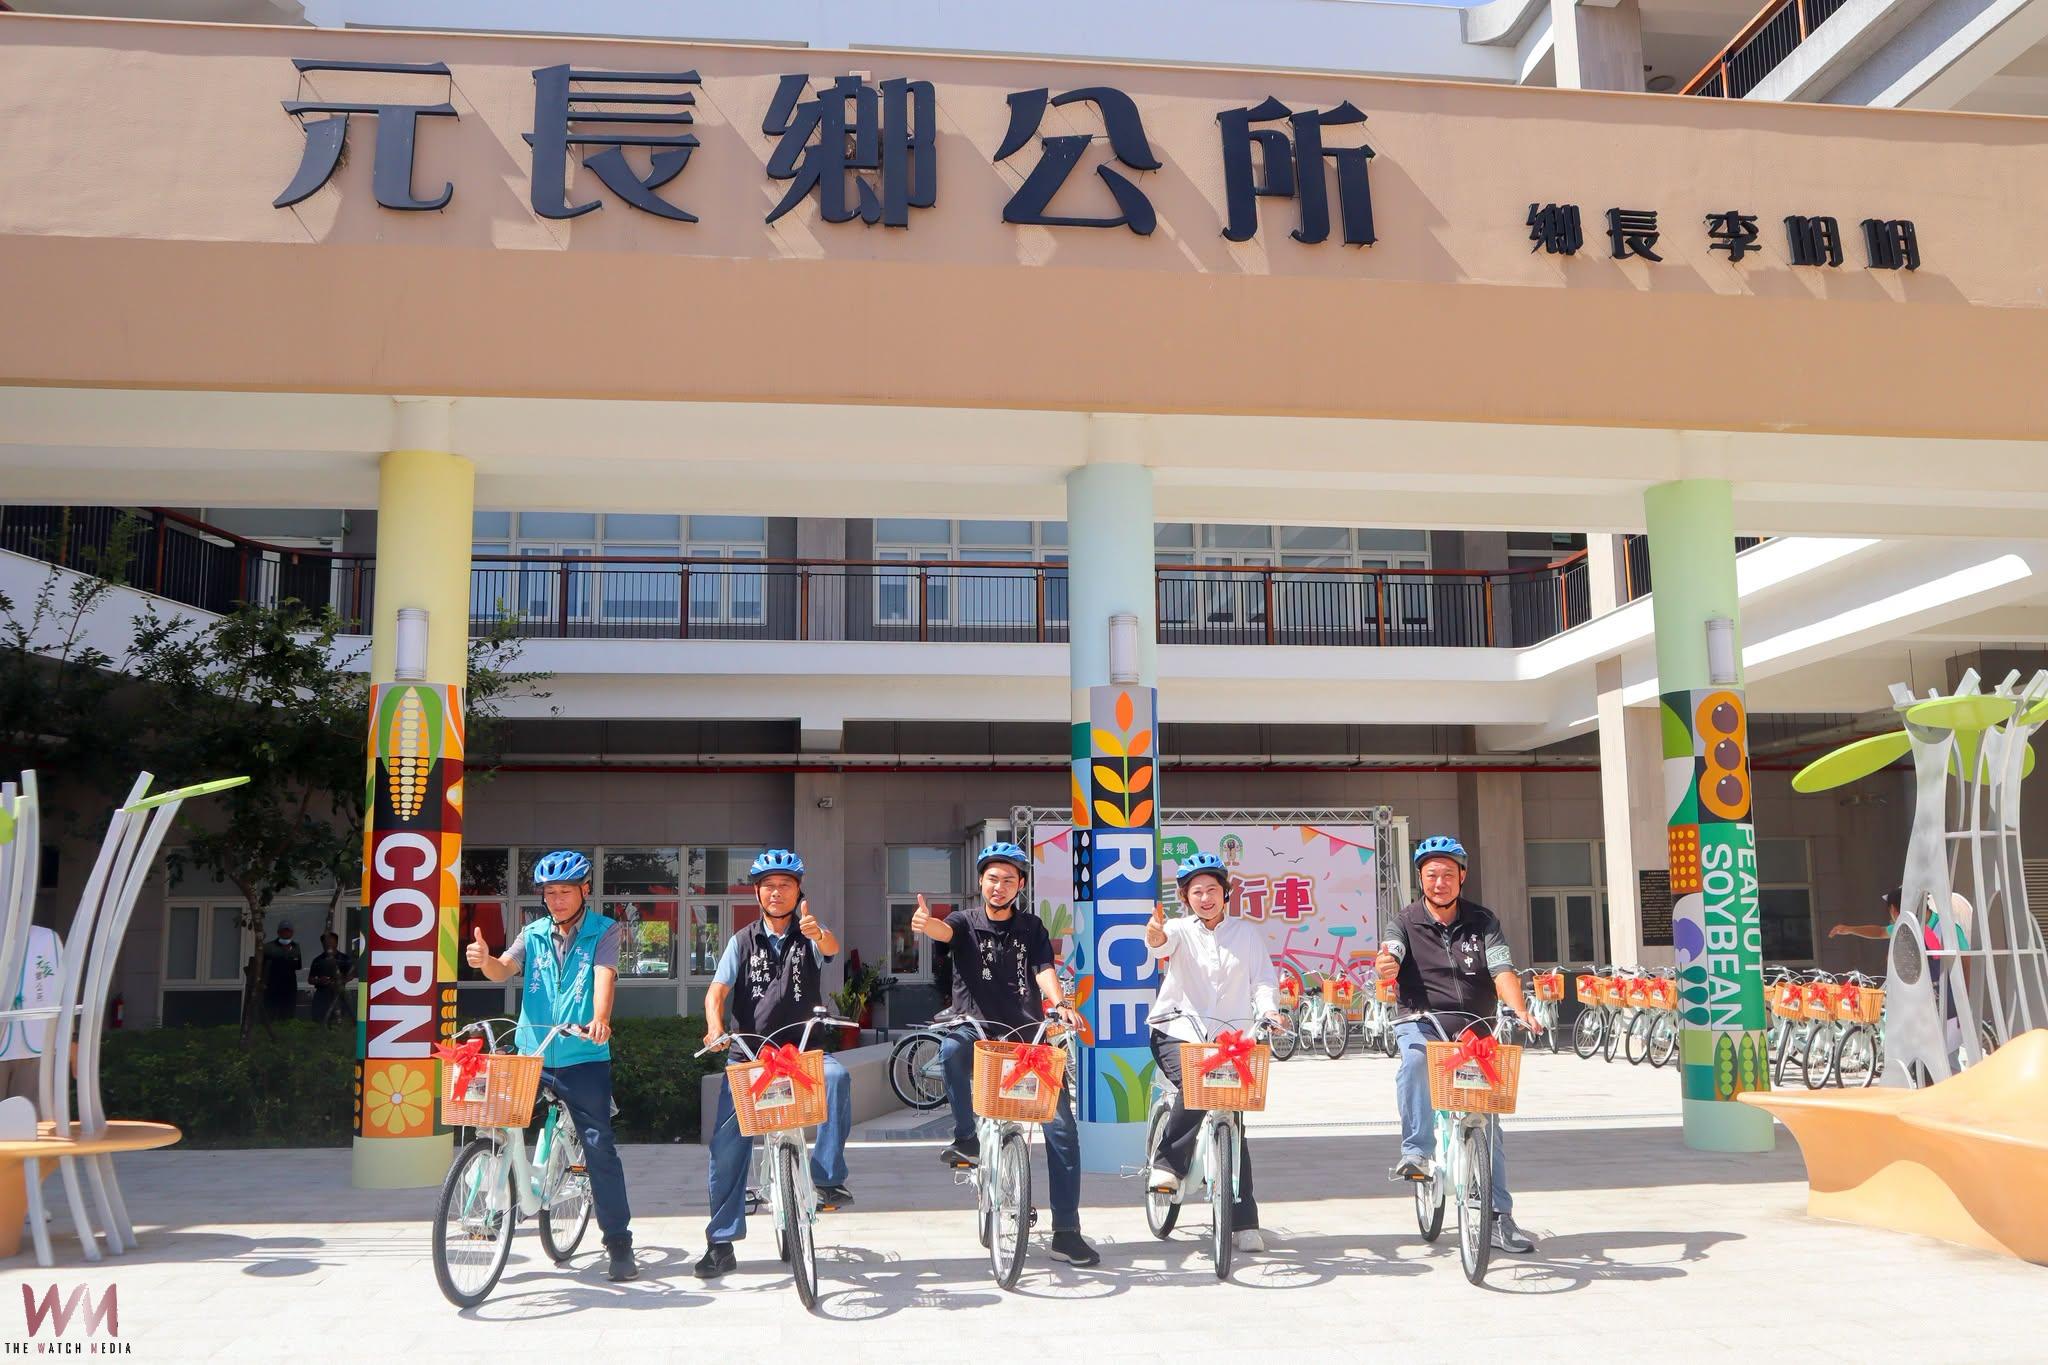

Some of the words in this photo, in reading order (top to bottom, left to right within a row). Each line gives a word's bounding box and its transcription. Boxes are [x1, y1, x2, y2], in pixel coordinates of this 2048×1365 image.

[273, 58, 1377, 245] 元長鄉公所
[368, 832, 438, 1059] CORN
[1095, 832, 1157, 1042] RICE
[1701, 843, 1744, 1031] SOYBEAN
[1735, 823, 1763, 975] PEANUT
